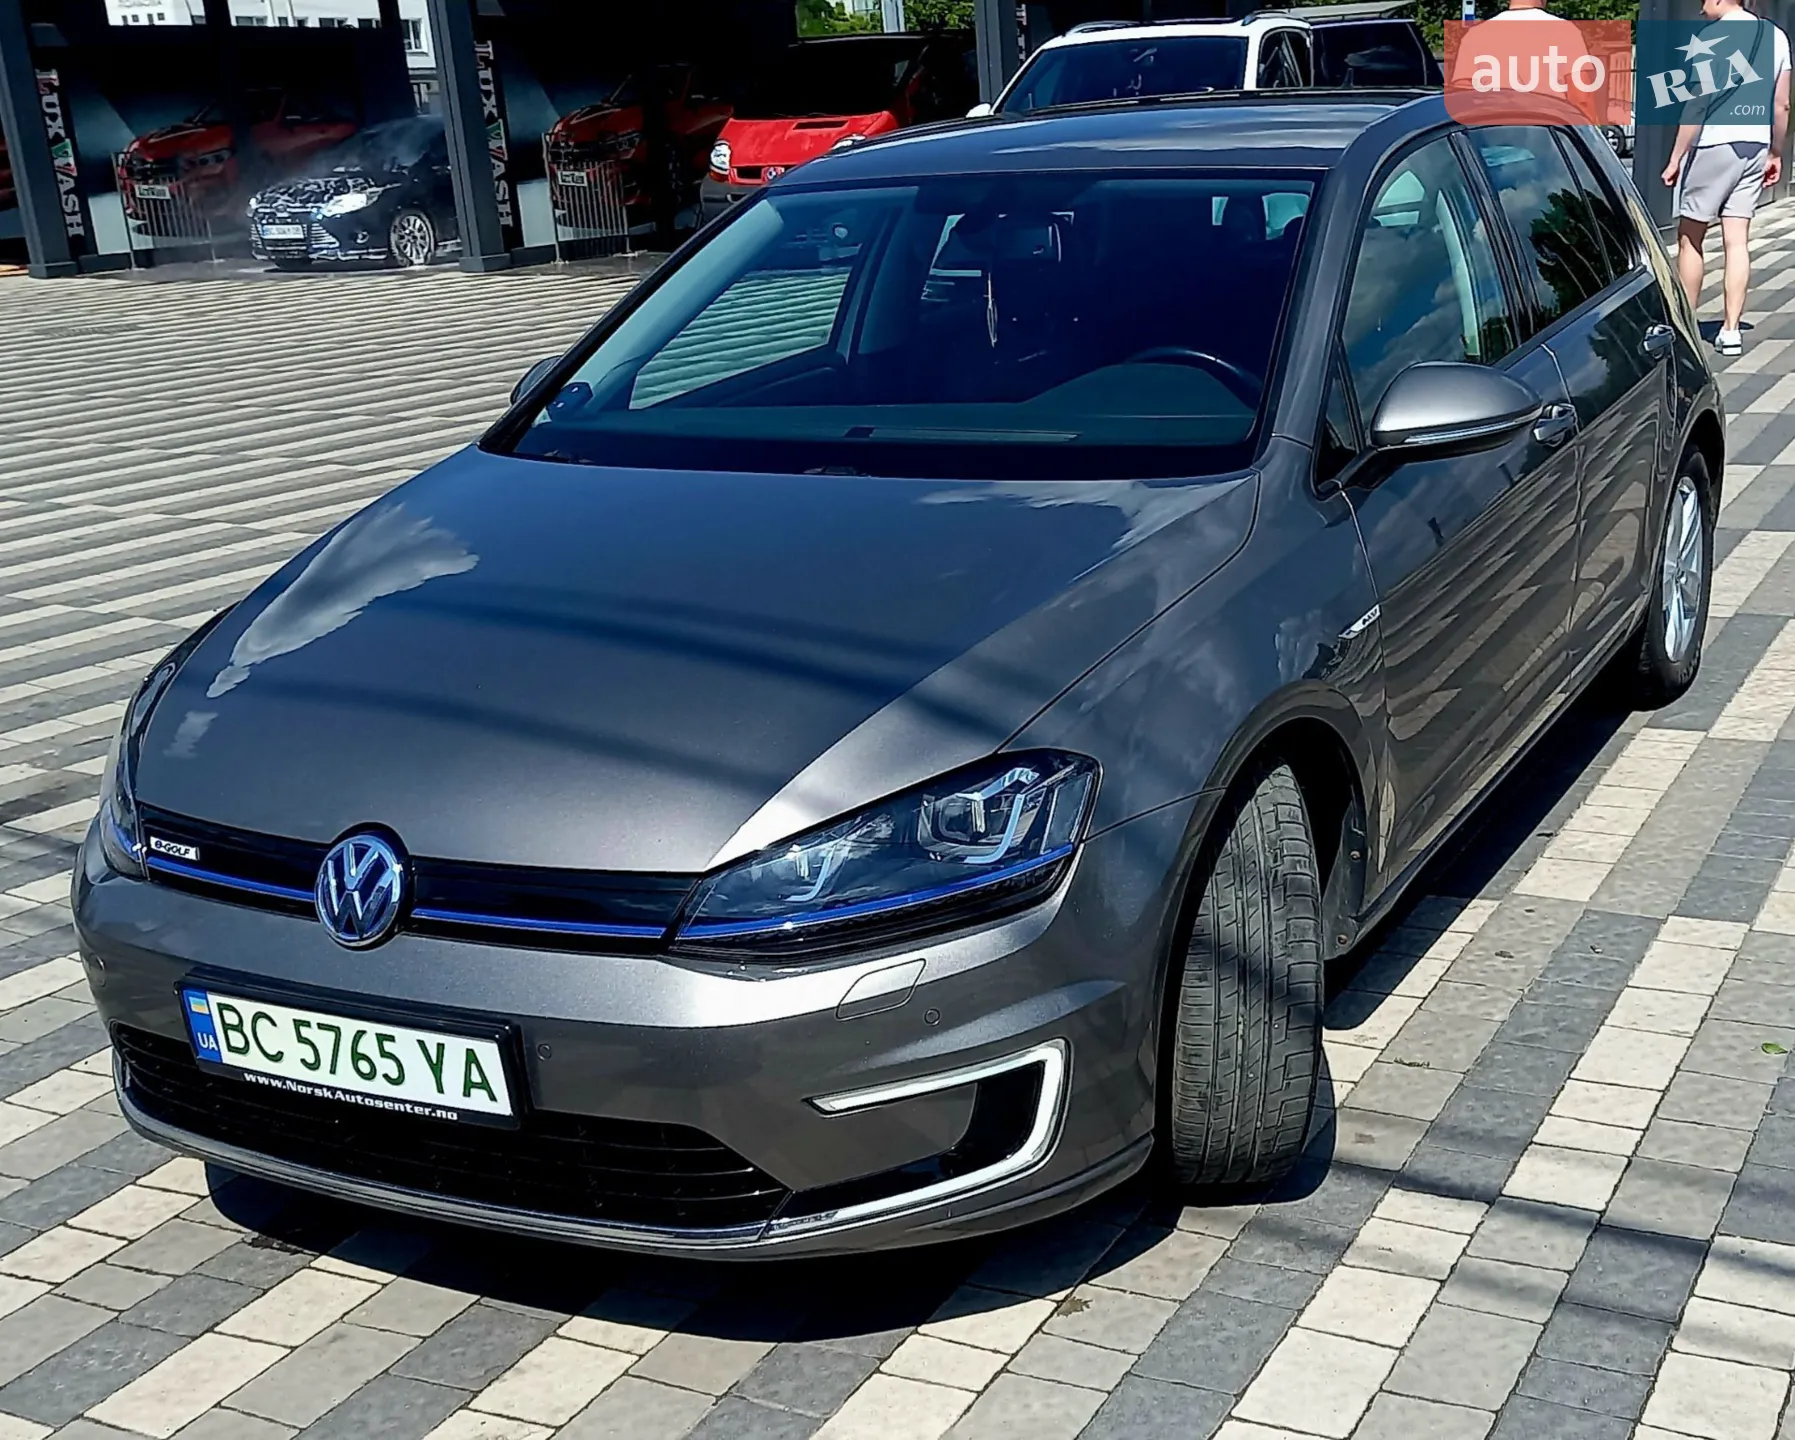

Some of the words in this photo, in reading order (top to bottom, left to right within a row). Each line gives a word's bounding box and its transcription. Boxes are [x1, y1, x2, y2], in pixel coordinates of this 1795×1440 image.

[198, 1032, 218, 1051] UA
[216, 1001, 285, 1063] BC
[292, 1018, 405, 1087] 5765
[416, 1039, 499, 1103] YA
[243, 1071, 458, 1121] www.NorskAutosenter.no
